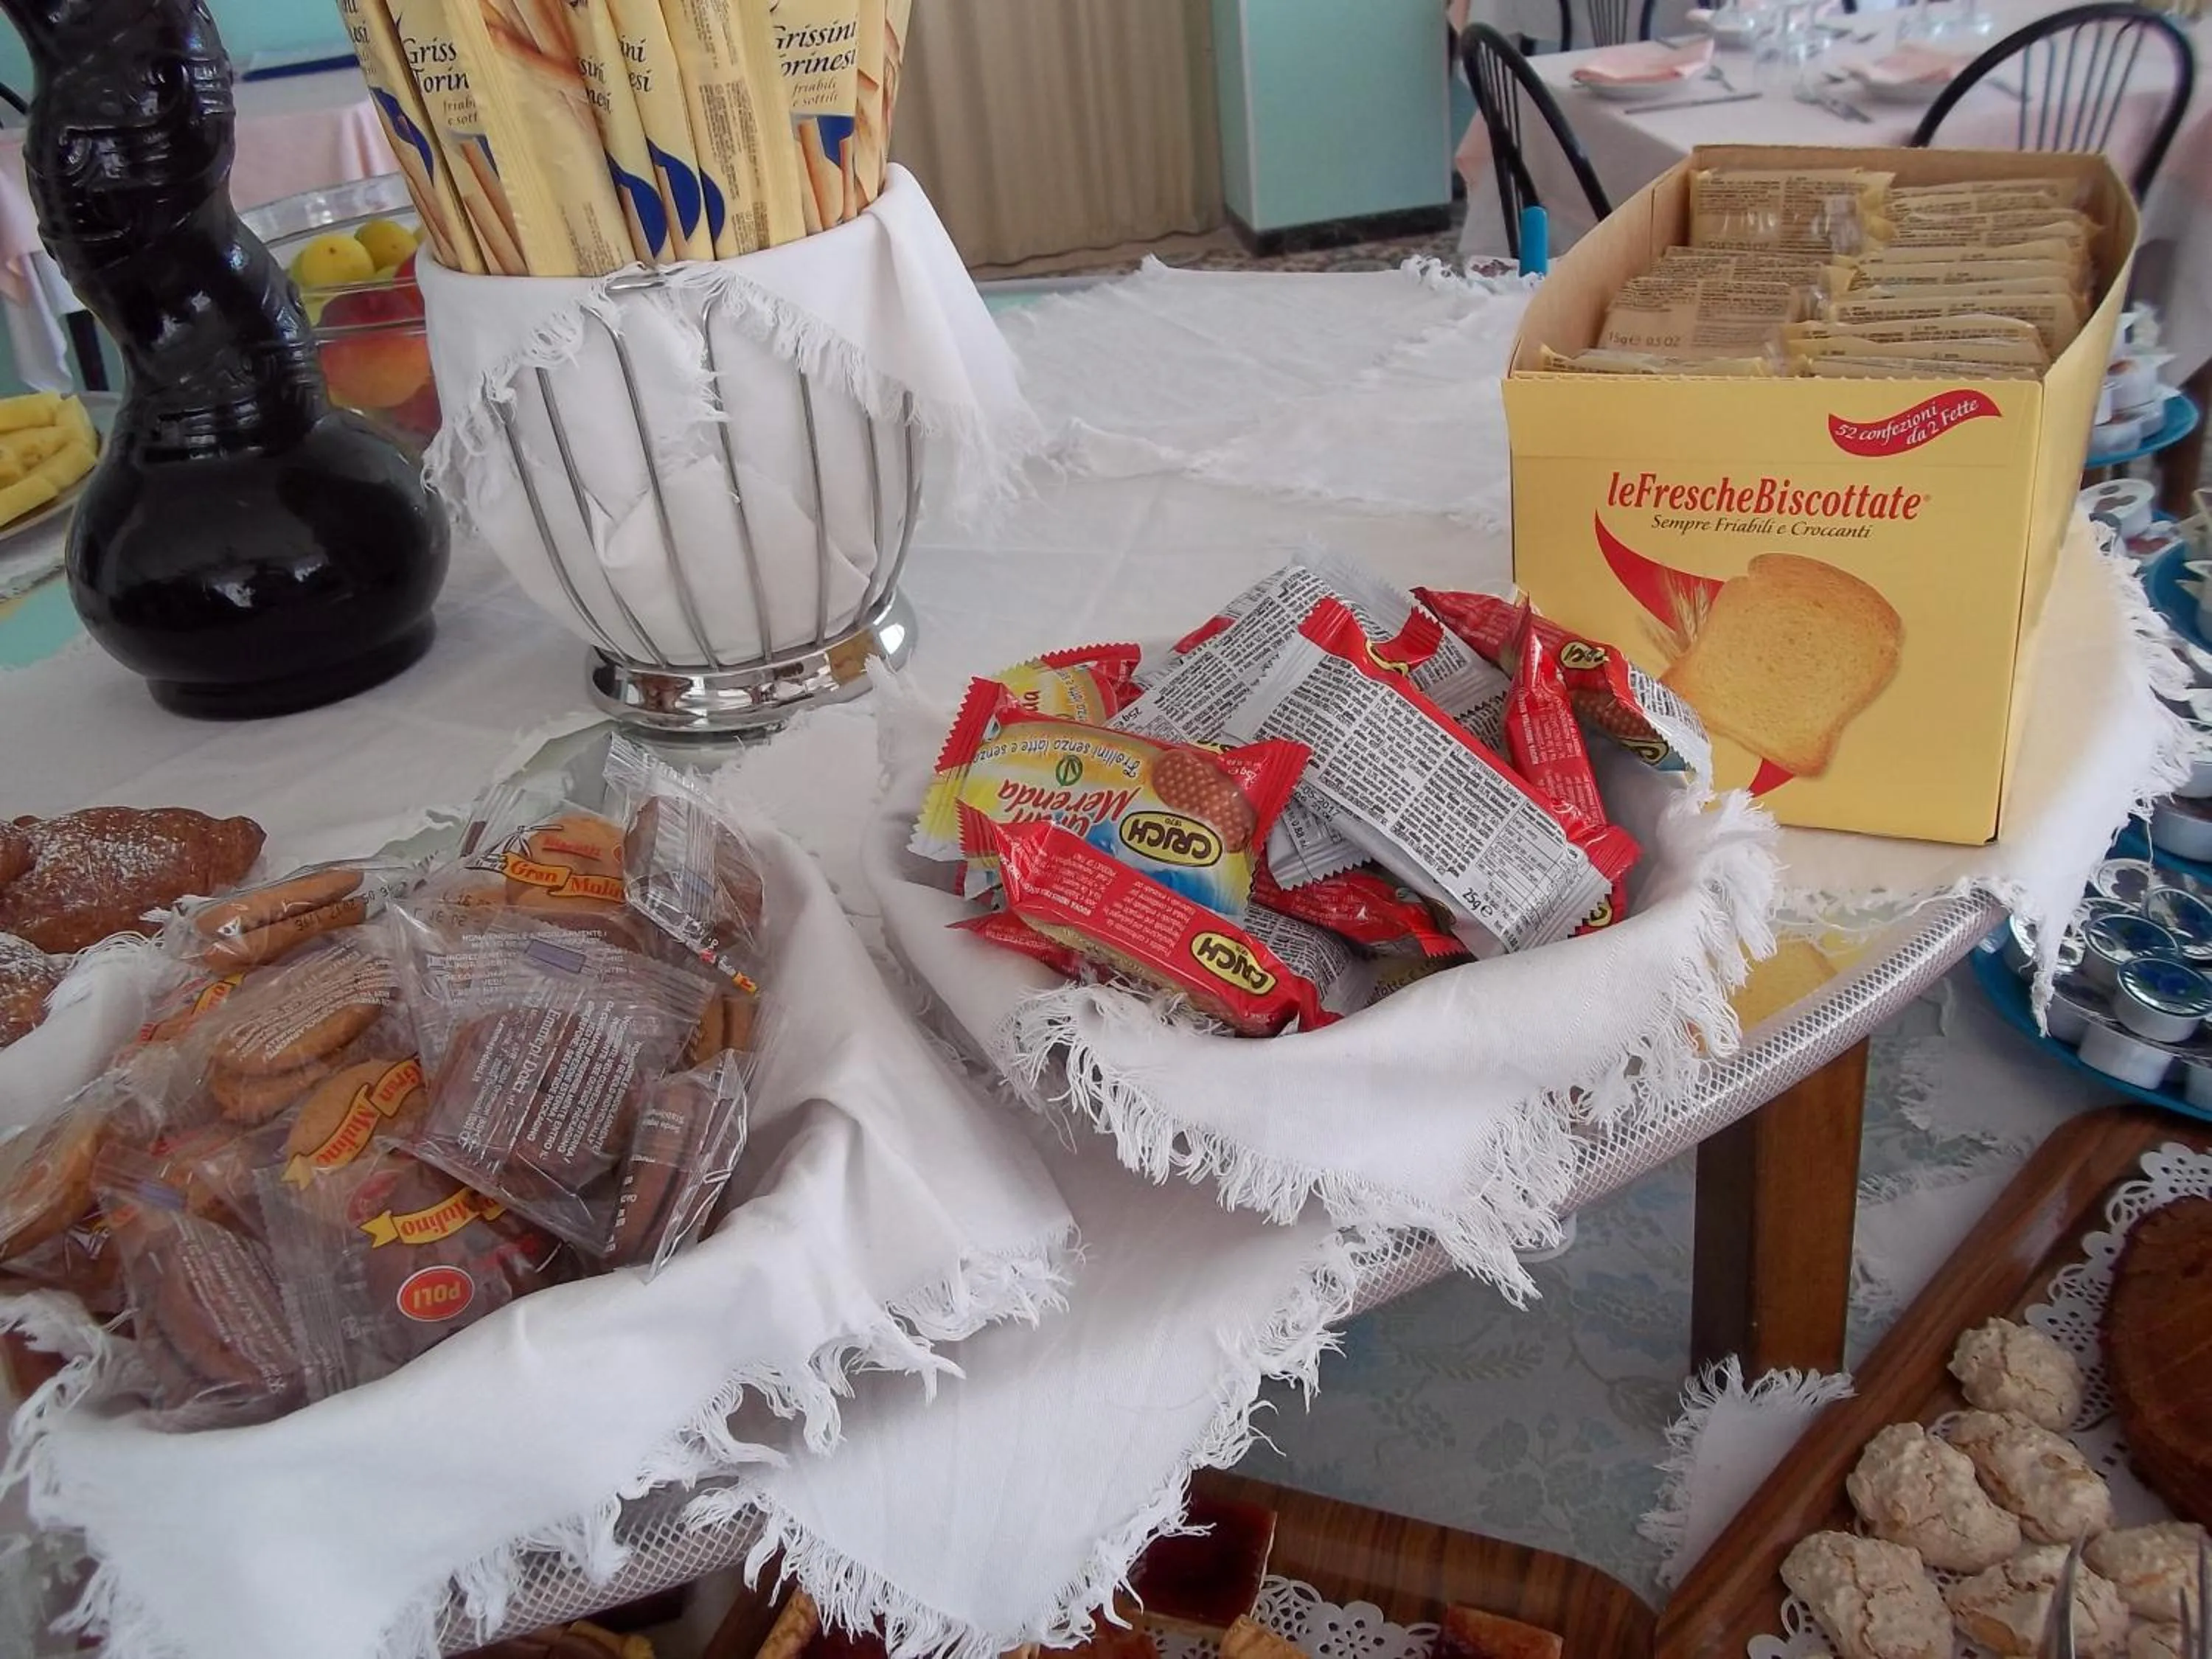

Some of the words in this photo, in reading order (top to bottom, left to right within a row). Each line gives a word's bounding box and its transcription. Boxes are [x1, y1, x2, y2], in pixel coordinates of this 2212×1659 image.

[401, 31, 457, 66] Griss
[779, 47, 858, 77] orinesi
[411, 64, 470, 94] Torin
[1834, 423, 1858, 440] 52
[1858, 400, 1938, 447] confezioni
[1905, 426, 1927, 445] da
[1927, 420, 1941, 435] 2
[1941, 397, 1980, 427] Fette
[1607, 470, 1922, 520] leFrescheBiscottate
[1651, 514, 1711, 538] Sempre
[1714, 516, 1774, 535] Friabili
[1776, 524, 1787, 535] e
[1790, 521, 1876, 539] Croccanti
[1121, 706, 1143, 724] 25g
[1020, 735, 1049, 757] latte
[1051, 737, 1091, 759] senza
[1088, 746, 1143, 779] Frollini
[998, 779, 1141, 824] Merenda
[1126, 820, 1212, 861] CRICH
[510, 860, 558, 886] Gran
[571, 874, 626, 902] Mulin
[1458, 886, 1485, 912] 25g
[1197, 936, 1271, 992] CRICH
[413, 1280, 462, 1302] POLI
